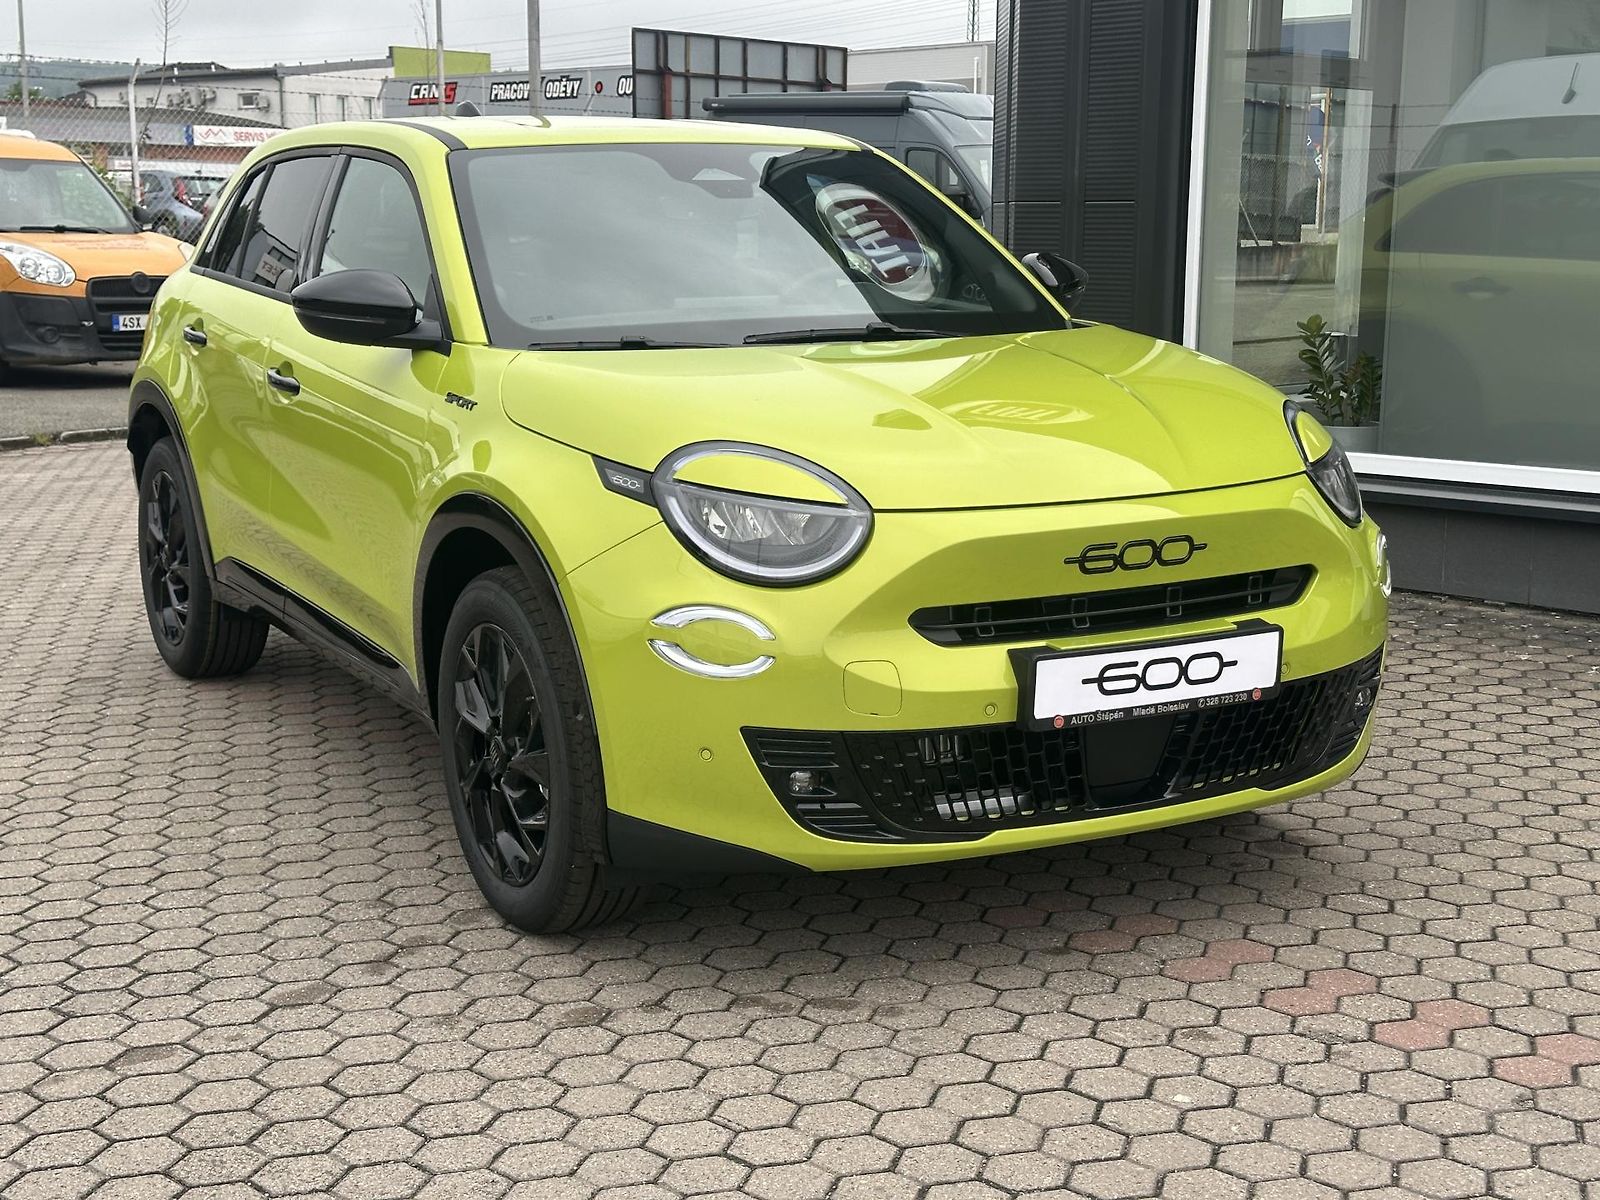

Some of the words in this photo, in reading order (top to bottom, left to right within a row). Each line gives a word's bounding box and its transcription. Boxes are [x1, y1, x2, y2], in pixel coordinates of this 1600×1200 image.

[409, 83, 457, 104] CANS
[490, 79, 542, 101] PRACOV
[545, 77, 582, 99] ODĚVY
[618, 77, 633, 97] OU
[122, 317, 142, 329] 4SX
[444, 391, 478, 411] SPORT
[1064, 534, 1208, 575] 600
[1081, 651, 1238, 696] 600
[1070, 714, 1095, 725] AUTO
[1096, 710, 1124, 723] Štěpán
[1132, 705, 1156, 717] Mladá
[1157, 702, 1190, 713] Boleslav
[1220, 695, 1234, 704] 723
